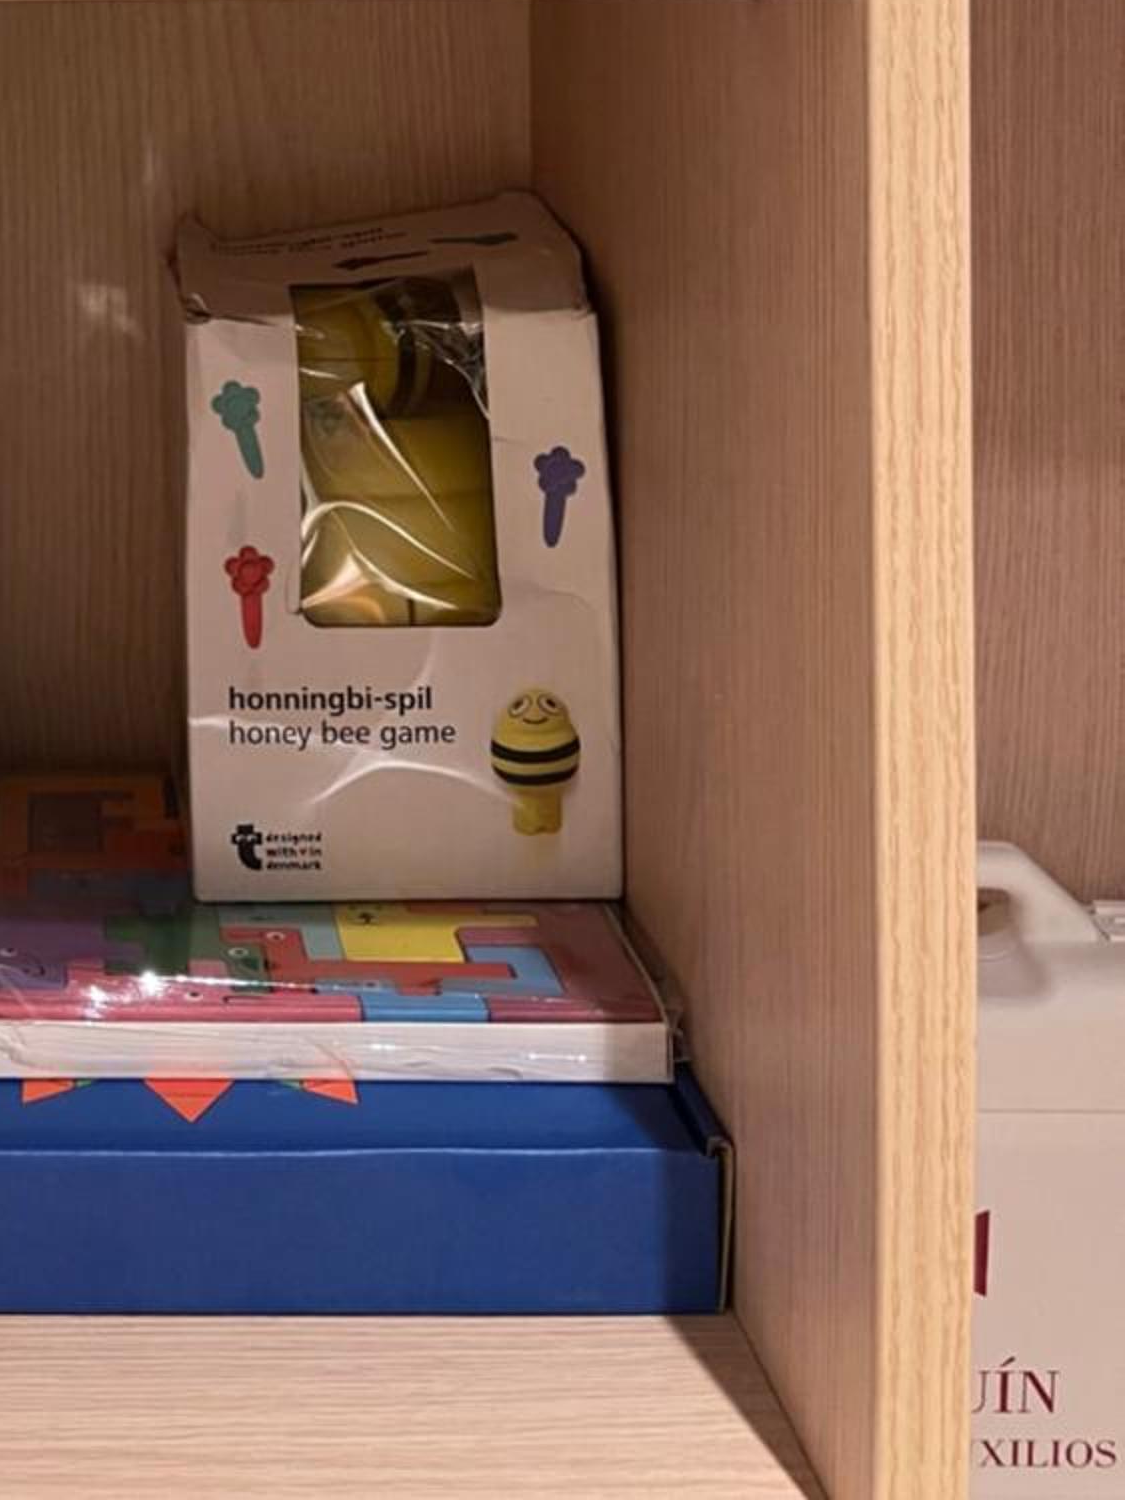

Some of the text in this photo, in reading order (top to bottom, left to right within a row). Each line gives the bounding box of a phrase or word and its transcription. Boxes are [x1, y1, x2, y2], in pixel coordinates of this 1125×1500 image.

[229, 686, 433, 716] honningbi-spil
[229, 719, 457, 750] honey bee game
[266, 831, 322, 847] designed
[266, 847, 298, 858] with
[266, 858, 322, 871] denmark
[970, 1438, 1117, 1468] XILIOS
